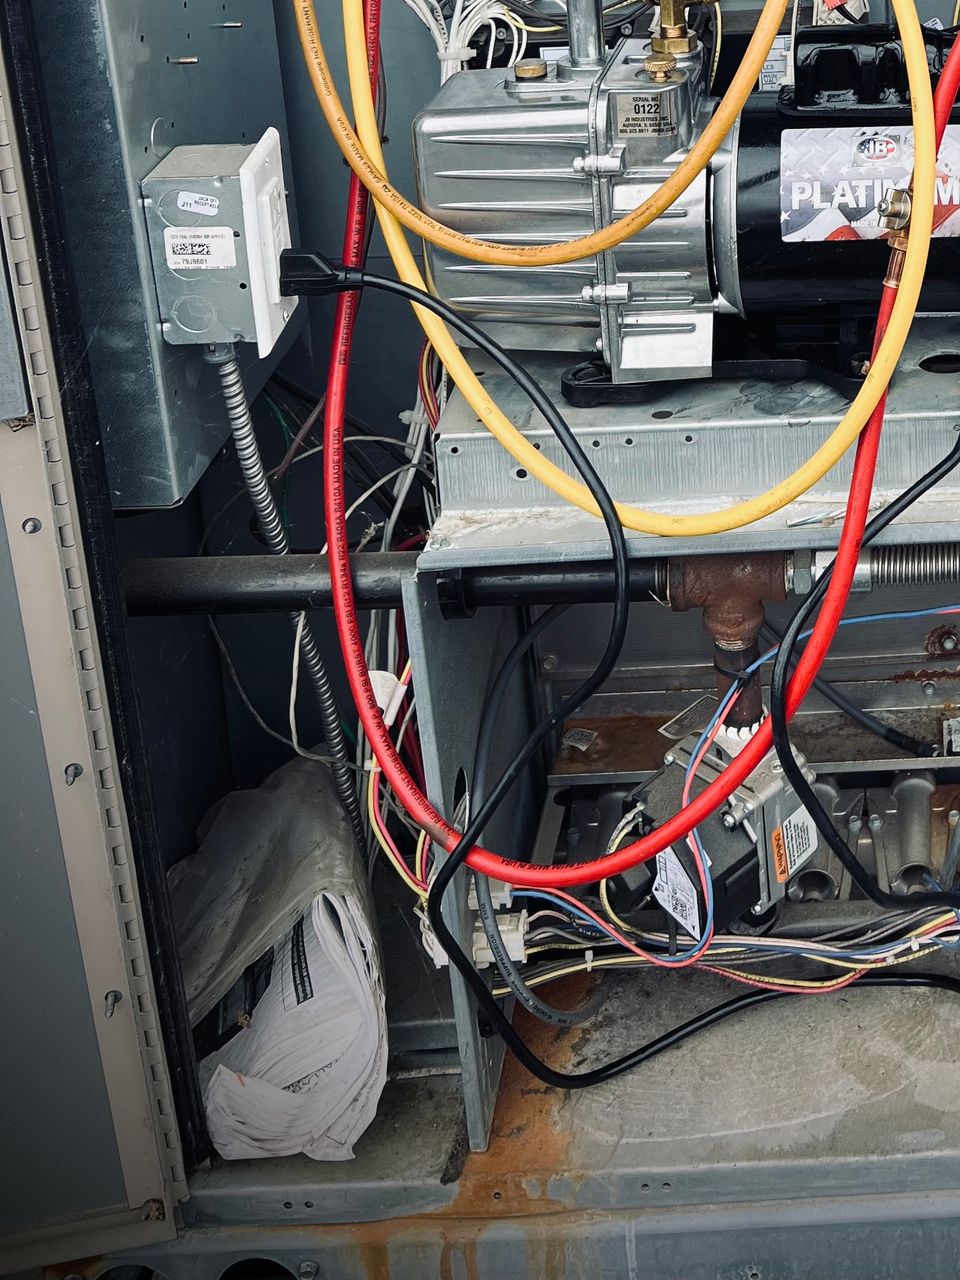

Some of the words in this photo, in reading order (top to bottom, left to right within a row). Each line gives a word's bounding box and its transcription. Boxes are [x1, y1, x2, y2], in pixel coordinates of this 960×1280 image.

[634, 104, 660, 114] 0122
[336, 117, 346, 131] USA
[344, 132, 352, 141] IN
[350, 142, 364, 162] MADE
[863, 139, 889, 156] JB
[791, 176, 960, 210] PLATIM
[851, 220, 869, 228] MADE
[870, 220, 877, 228] IN
[333, 426, 341, 444] USA
[333, 447, 340, 458] IN
[333, 458, 341, 482] MADE
[335, 516, 344, 543] R404A
[350, 622, 359, 646] 4000
[353, 645, 367, 678] BURST
[361, 677, 371, 693] PSI
[365, 695, 377, 710] 800
[379, 733, 390, 750] MAX
[386, 747, 403, 770] HOSE
[398, 769, 447, 831] REFRIGERANT
[500, 858, 517, 869] USA
[517, 862, 527, 870] IN
[526, 863, 551, 871] MADE
